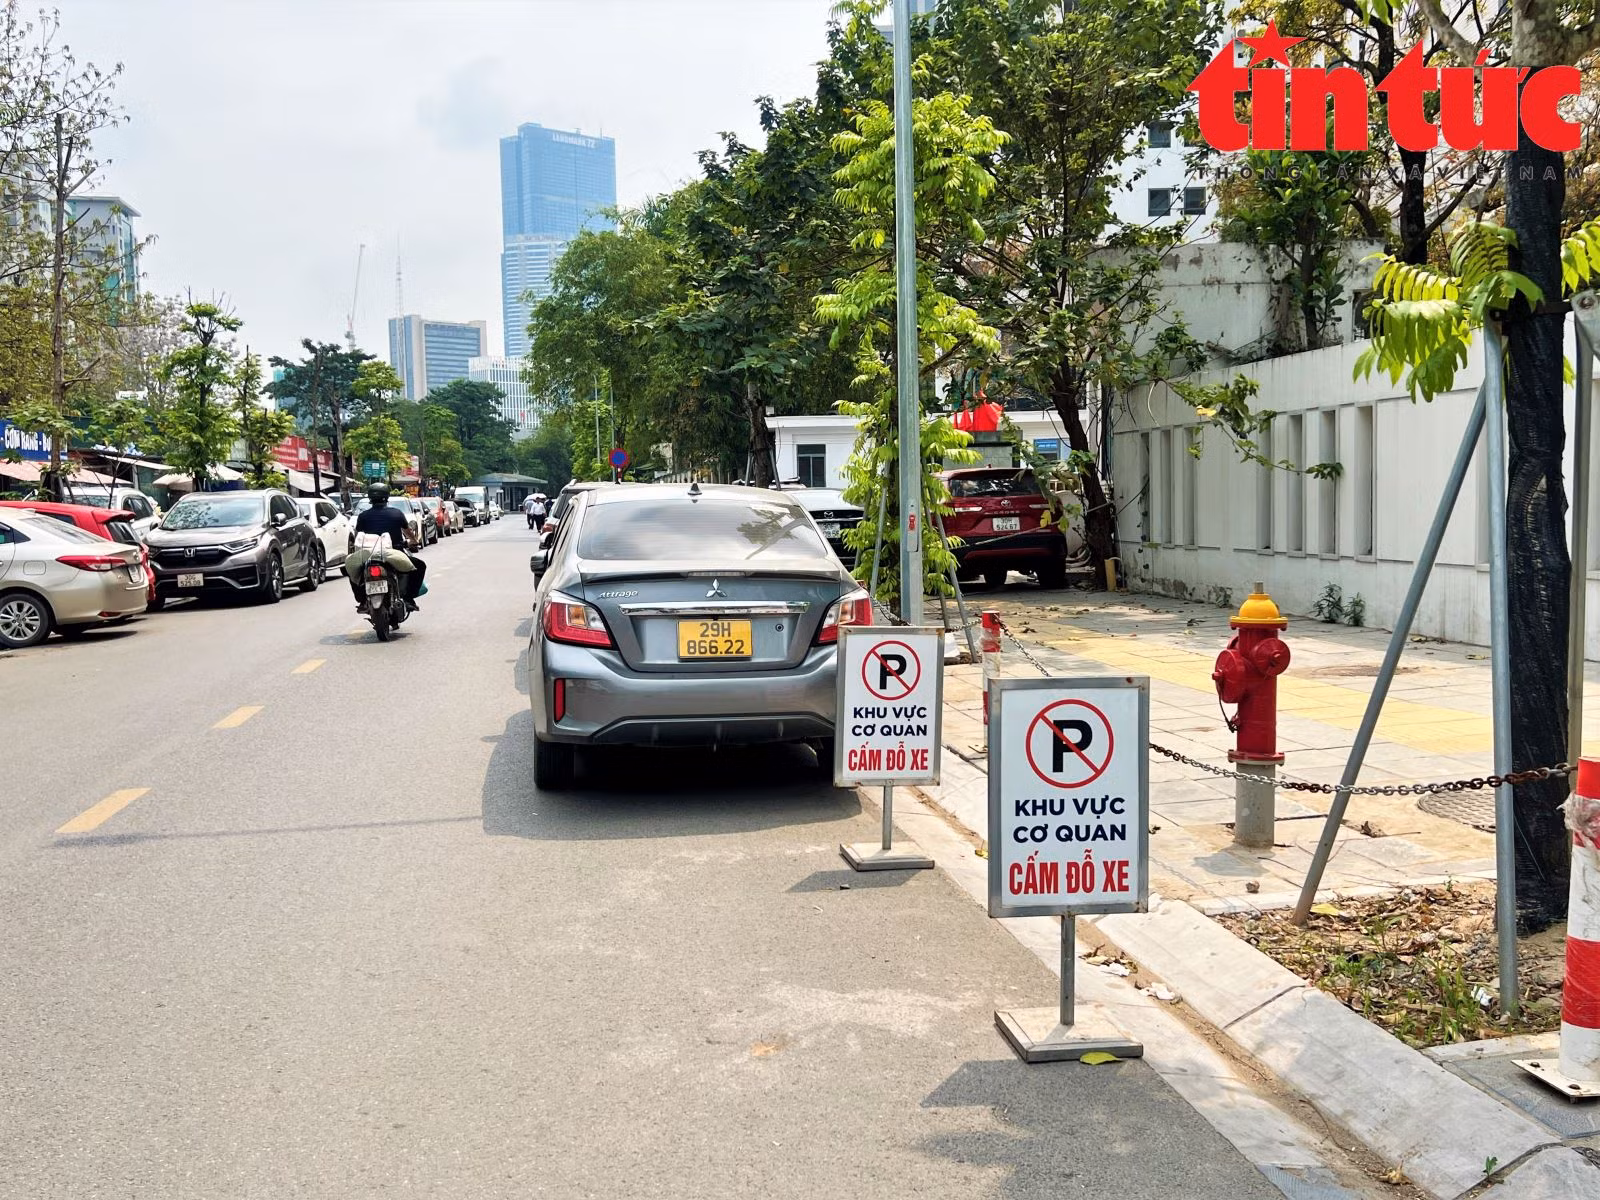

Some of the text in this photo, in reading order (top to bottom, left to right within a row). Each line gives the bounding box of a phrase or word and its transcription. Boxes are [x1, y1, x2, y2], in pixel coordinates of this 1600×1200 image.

[699, 622, 732, 638] 29H
[686, 639, 745, 655] 866.22
[853, 704, 927, 722] KHU VỰC
[851, 723, 928, 737] CƠ QUAN
[848, 740, 929, 771] CẤM ĐỖ XE
[1014, 794, 1126, 820] KHU VỰC
[1012, 823, 1127, 844] CƠ QUAN
[1009, 848, 1130, 896] CẤM ĐỖ XE
